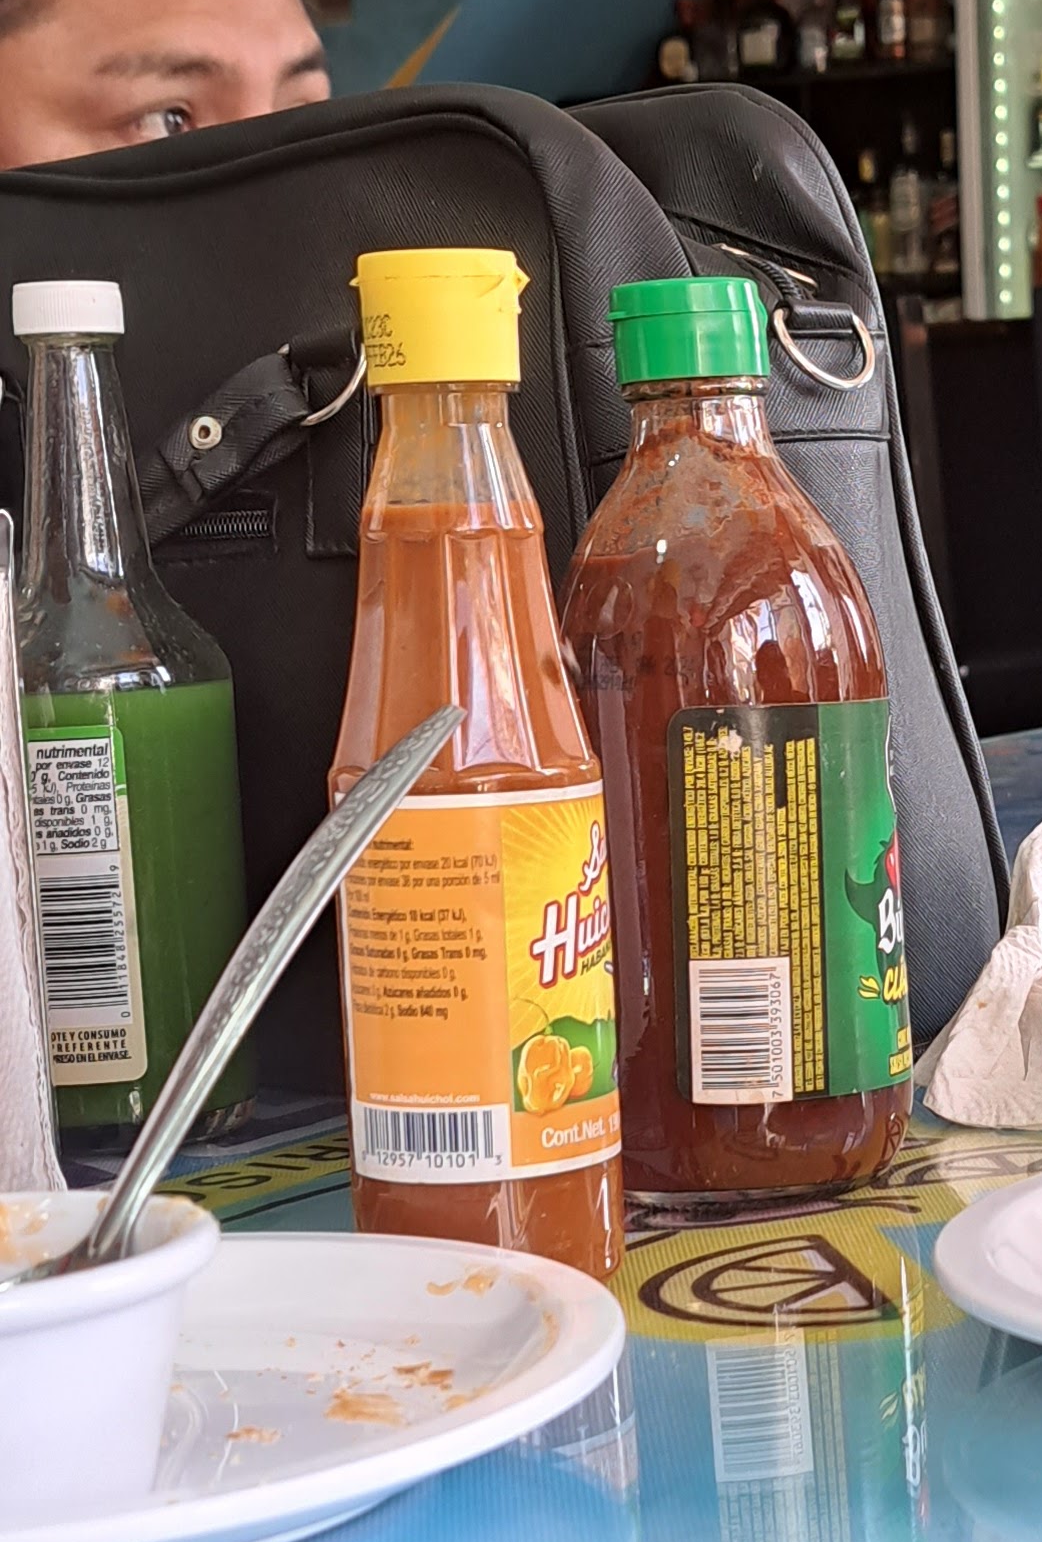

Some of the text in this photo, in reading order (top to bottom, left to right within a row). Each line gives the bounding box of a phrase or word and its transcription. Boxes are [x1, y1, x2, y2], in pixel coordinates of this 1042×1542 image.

[36, 743, 108, 759] nutrimental
[35, 758, 109, 772] por envase 12
[58, 770, 110, 781] Contenido
[76, 793, 111, 803] Grasas
[50, 806, 75, 815] trans
[80, 805, 87, 814] 0
[94, 826, 100, 836] 0
[61, 838, 90, 849] Sodio
[91, 838, 98, 847] 2
[100, 839, 107, 849] g
[69, 1031, 75, 1041] Y
[78, 1028, 127, 1040] CONSUMO
[424, 1153, 476, 1168] 10101
